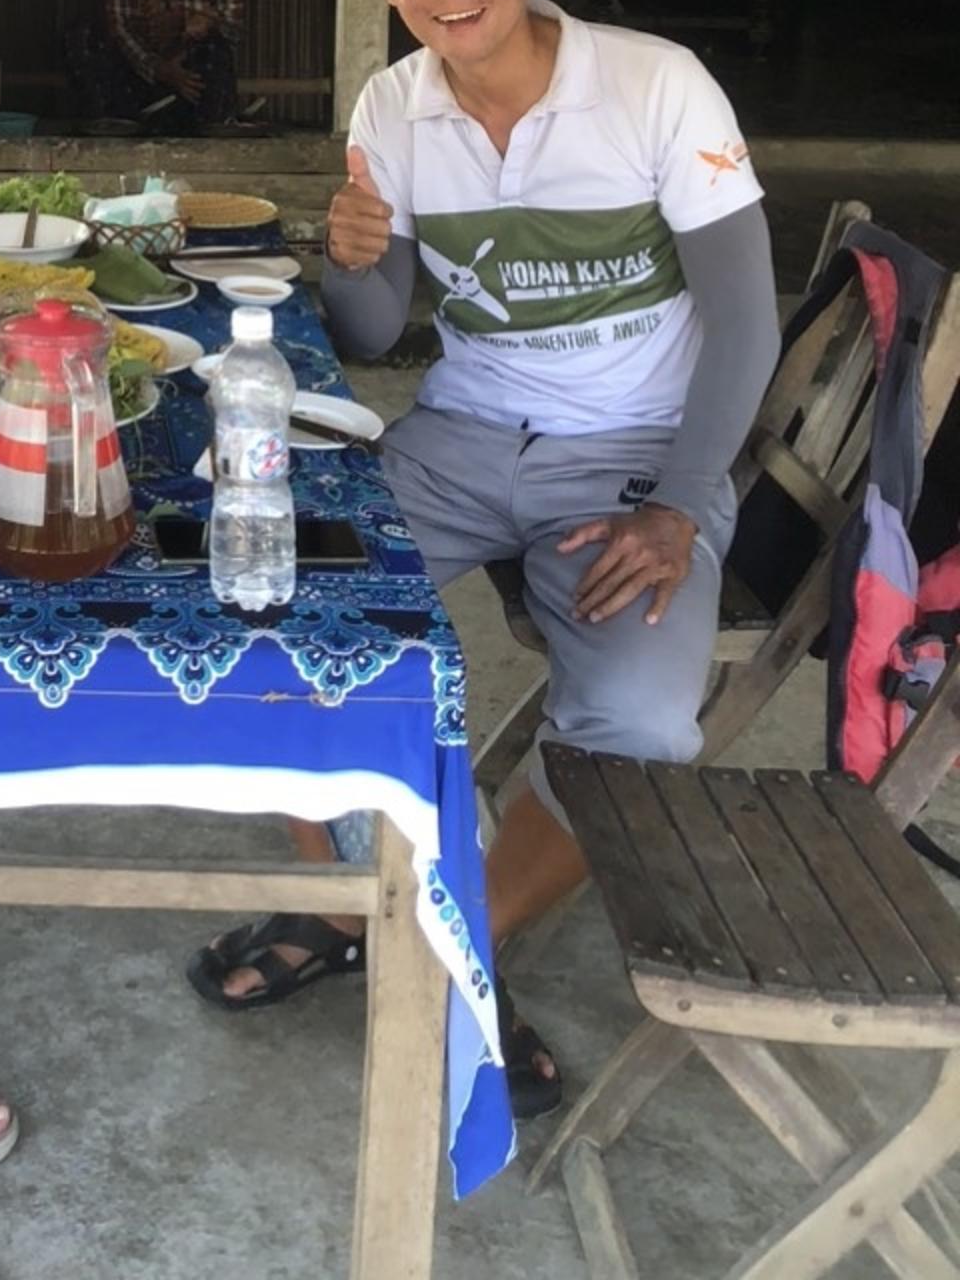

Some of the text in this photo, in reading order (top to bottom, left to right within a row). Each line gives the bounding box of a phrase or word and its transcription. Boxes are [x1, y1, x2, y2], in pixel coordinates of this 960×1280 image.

[497, 247, 654, 288] HOIAN KAYAK
[612, 312, 661, 342] AWAITS
[626, 477, 659, 495] NIK
